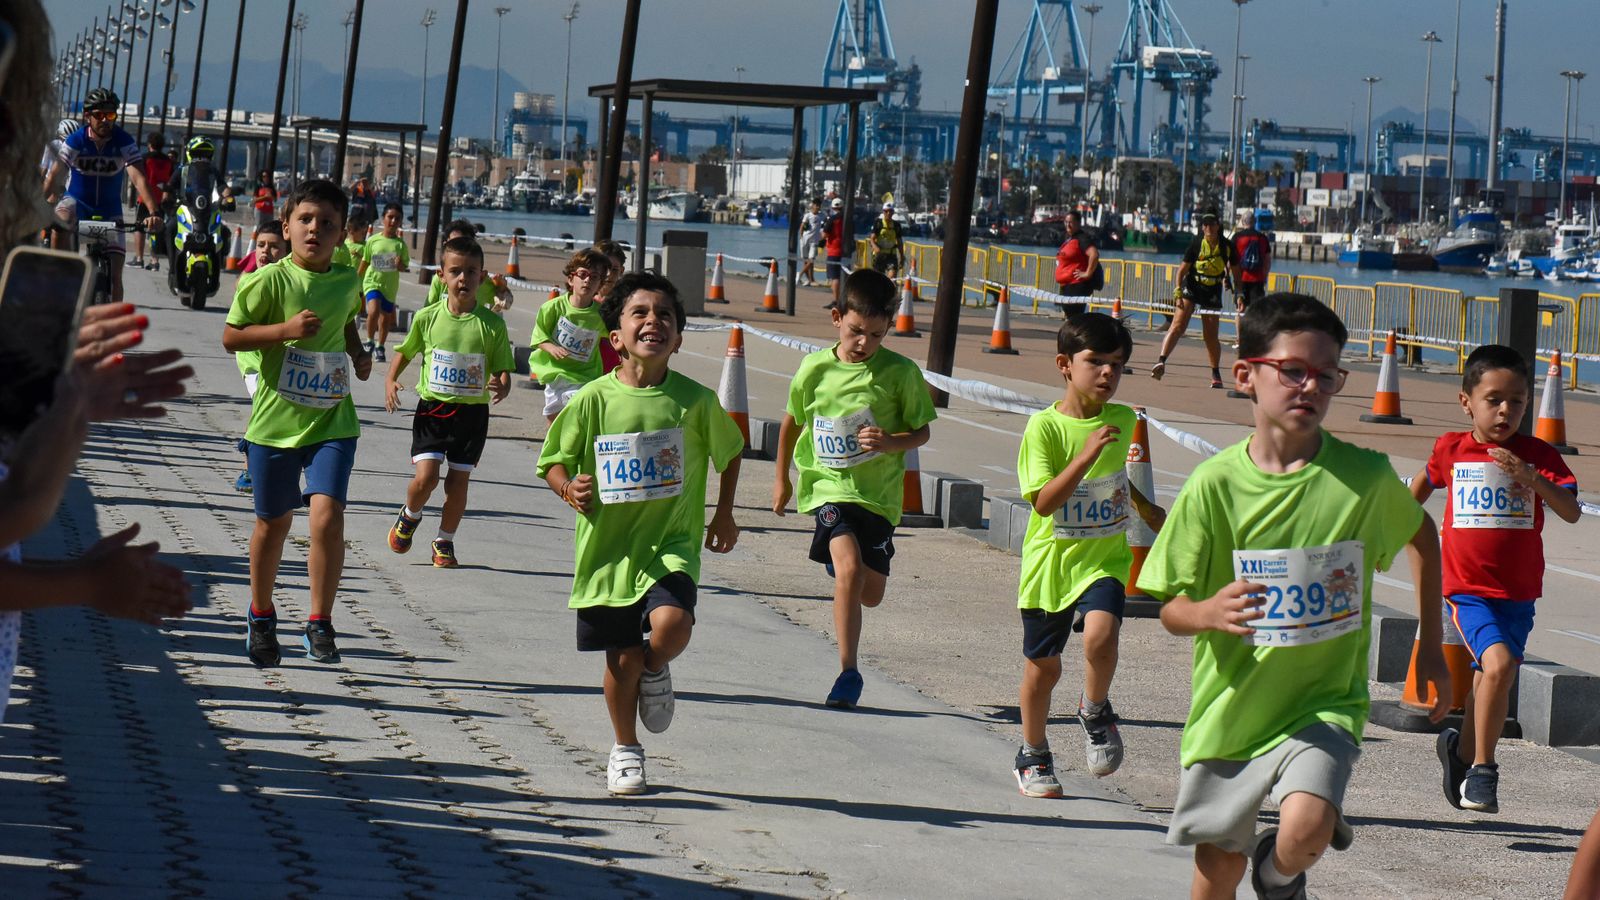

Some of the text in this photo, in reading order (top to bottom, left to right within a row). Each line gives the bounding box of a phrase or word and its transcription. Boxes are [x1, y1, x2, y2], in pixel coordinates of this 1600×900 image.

[286, 367, 331, 393] 1044
[433, 365, 467, 384] 1488
[598, 441, 613, 453] XXI
[817, 434, 858, 454] 1036
[602, 456, 658, 485] 1484
[1455, 468, 1469, 479] XXI
[1457, 486, 1507, 510] 1496
[1240, 559, 1262, 574] XXI
[1263, 566, 1288, 574] Popular
